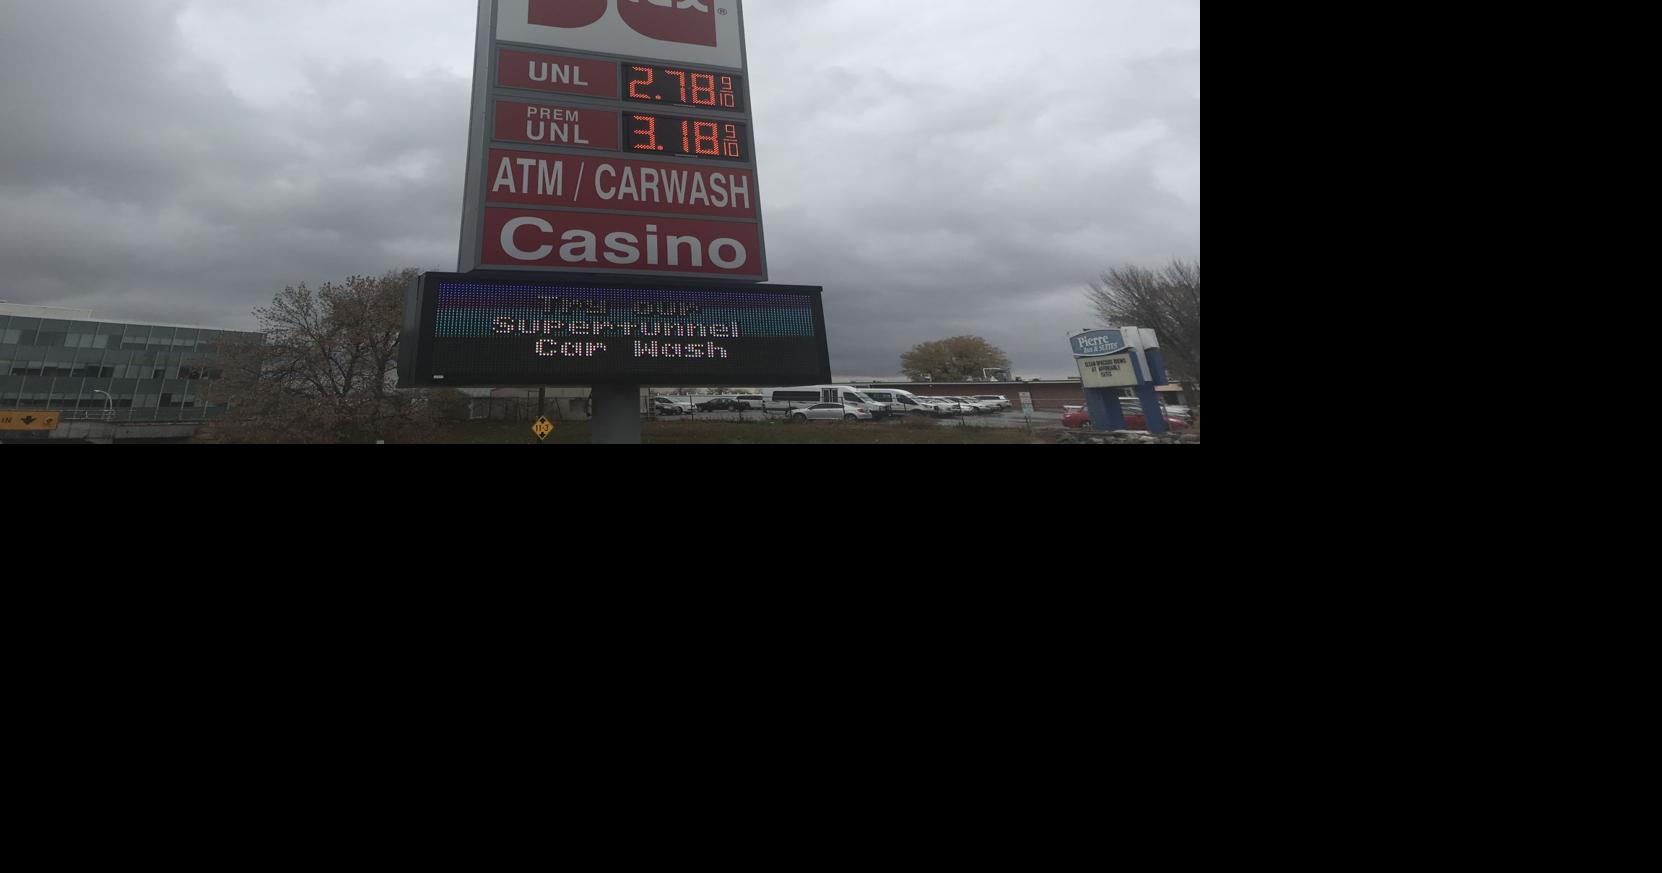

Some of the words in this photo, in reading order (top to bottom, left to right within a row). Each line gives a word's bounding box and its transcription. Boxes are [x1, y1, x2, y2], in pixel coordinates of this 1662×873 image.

[528, 60, 588, 86] UNL
[629, 66, 716, 106] 2.78
[527, 106, 579, 122] PREM
[526, 119, 589, 145] UNL
[633, 115, 720, 156] 3.18
[492, 156, 563, 196] ATM
[594, 163, 750, 209] CARWASH
[500, 216, 747, 269] Casino
[535, 338, 607, 357] Car
[634, 340, 728, 359] Wash
[1077, 335, 1109, 347] Pierre
